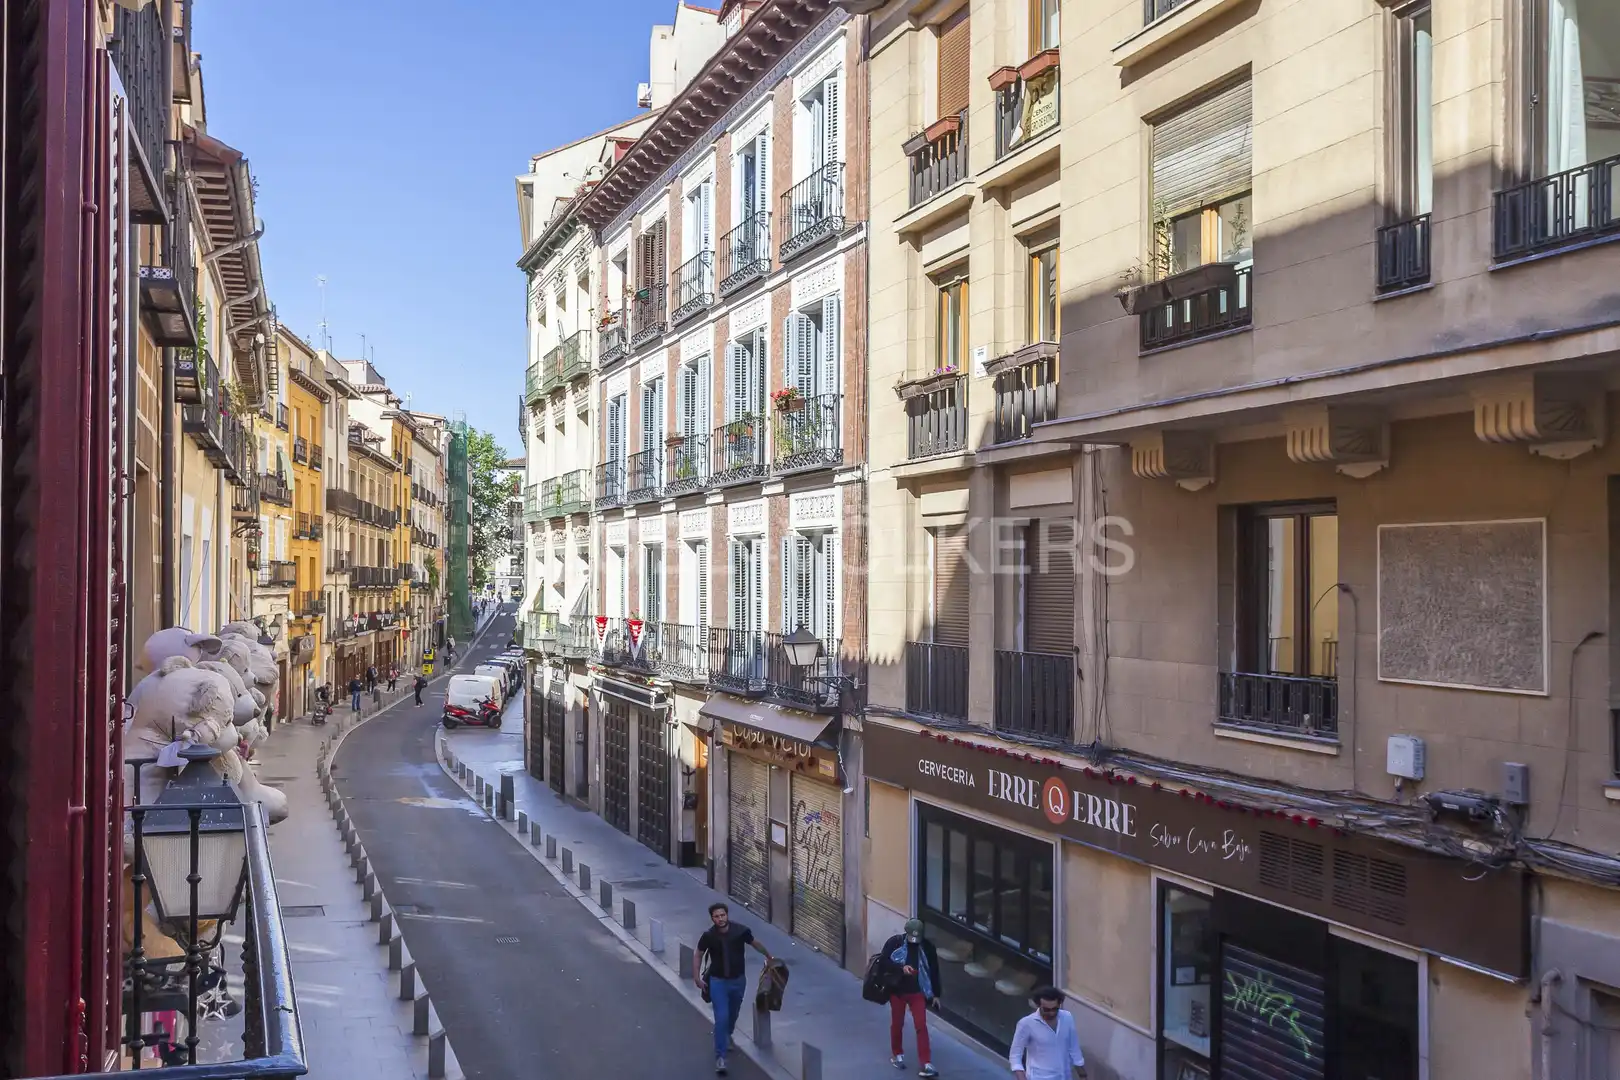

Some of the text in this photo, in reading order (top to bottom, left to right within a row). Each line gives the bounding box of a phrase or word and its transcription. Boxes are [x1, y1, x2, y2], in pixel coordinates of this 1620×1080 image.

[987, 768, 1137, 838] ERRE Q ERRE
[1149, 823, 1253, 862] Sabor Cava Baja
